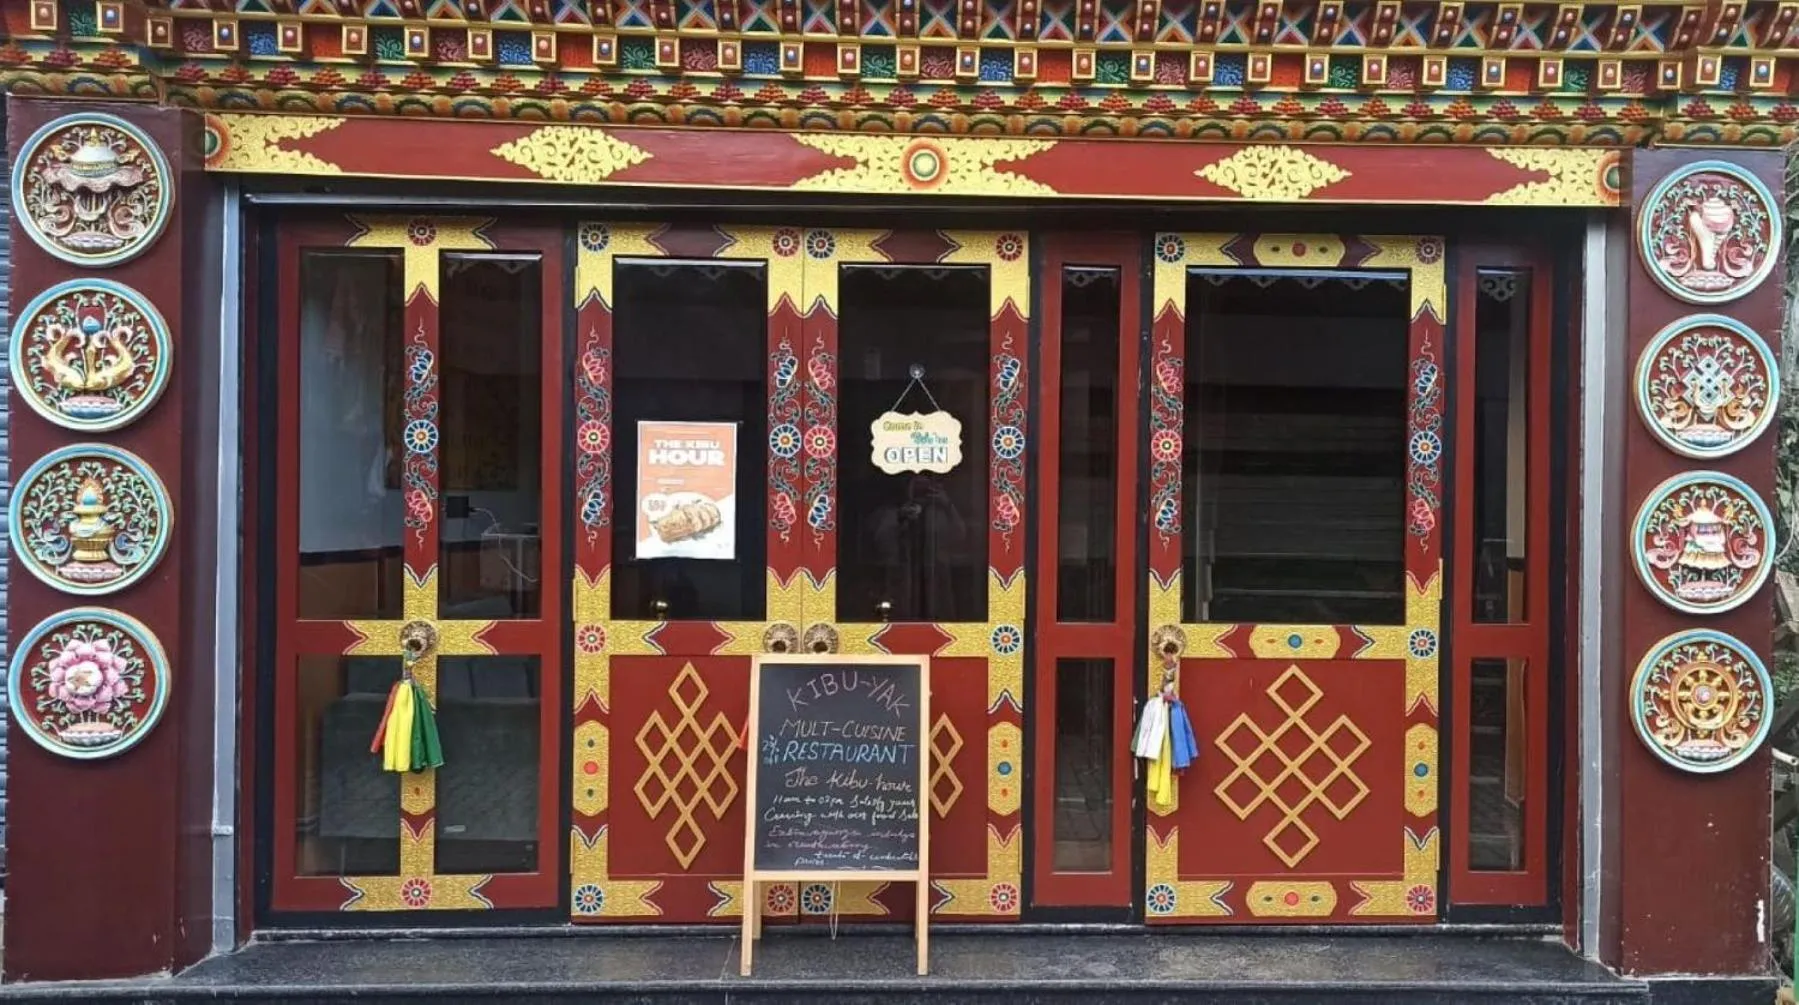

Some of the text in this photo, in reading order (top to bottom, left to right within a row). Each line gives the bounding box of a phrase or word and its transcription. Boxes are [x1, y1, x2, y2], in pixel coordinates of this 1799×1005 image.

[647, 448, 725, 466] HOUR
[884, 446, 949, 464] OPEN
[779, 718, 907, 742] MULT-CUISINE
[782, 739, 916, 764] RESTAURANT
[784, 766, 819, 788] The
